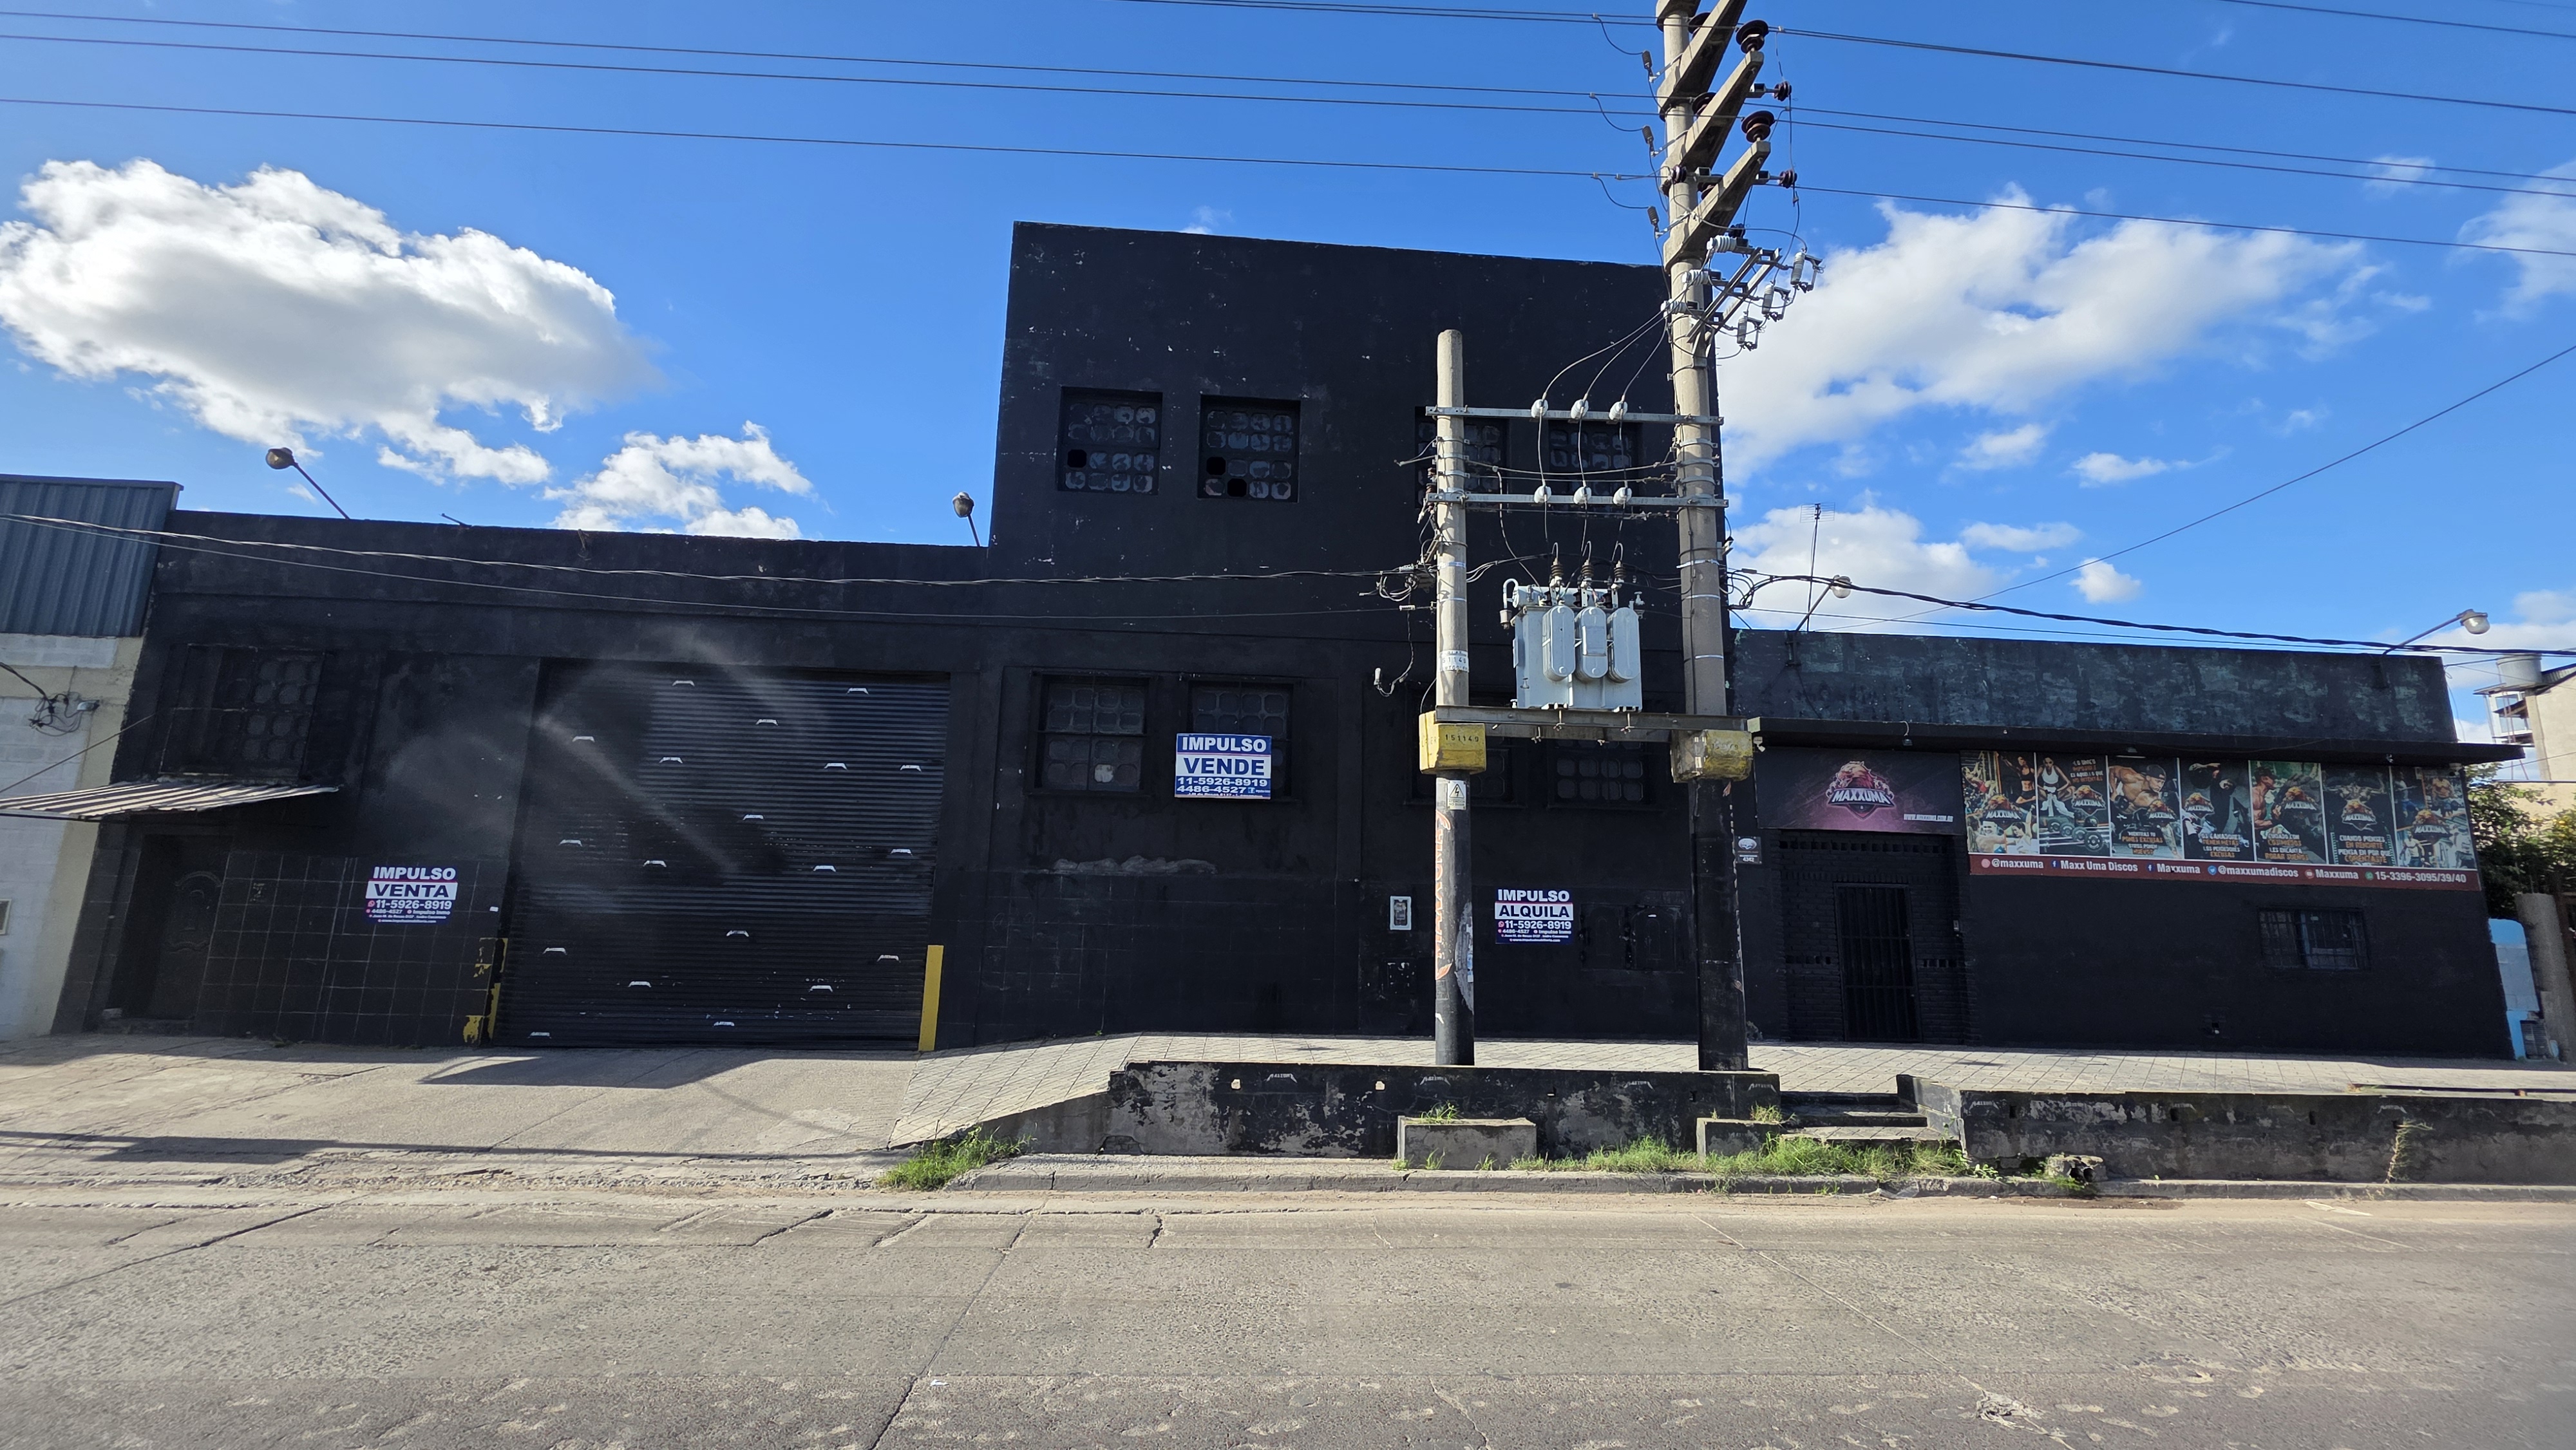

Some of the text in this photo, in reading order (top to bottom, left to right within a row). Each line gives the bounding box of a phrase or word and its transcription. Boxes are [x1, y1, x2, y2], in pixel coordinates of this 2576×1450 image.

[1182, 737, 1266, 752] IMPULSO
[1184, 757, 1264, 776] VENDE
[1177, 777, 1267, 787] 11-5926-8919
[1177, 786, 1246, 794] 4486-4527
[1832, 789, 1891, 804] MAXXUMA
[373, 867, 456, 880] IMPULSO
[1991, 858, 2467, 883] @maxxuma Maxx Uma Discos Maxxuma @maxxumadiscos Maxxuma 15-3396-3095/39/40
[374, 883, 449, 898] VENTA
[1498, 889, 1569, 902] IMPULSO
[376, 899, 452, 910] 11-5926-8919
[1499, 905, 1569, 918] ALQUILA
[1505, 920, 1571, 930] 11-5926-8919
